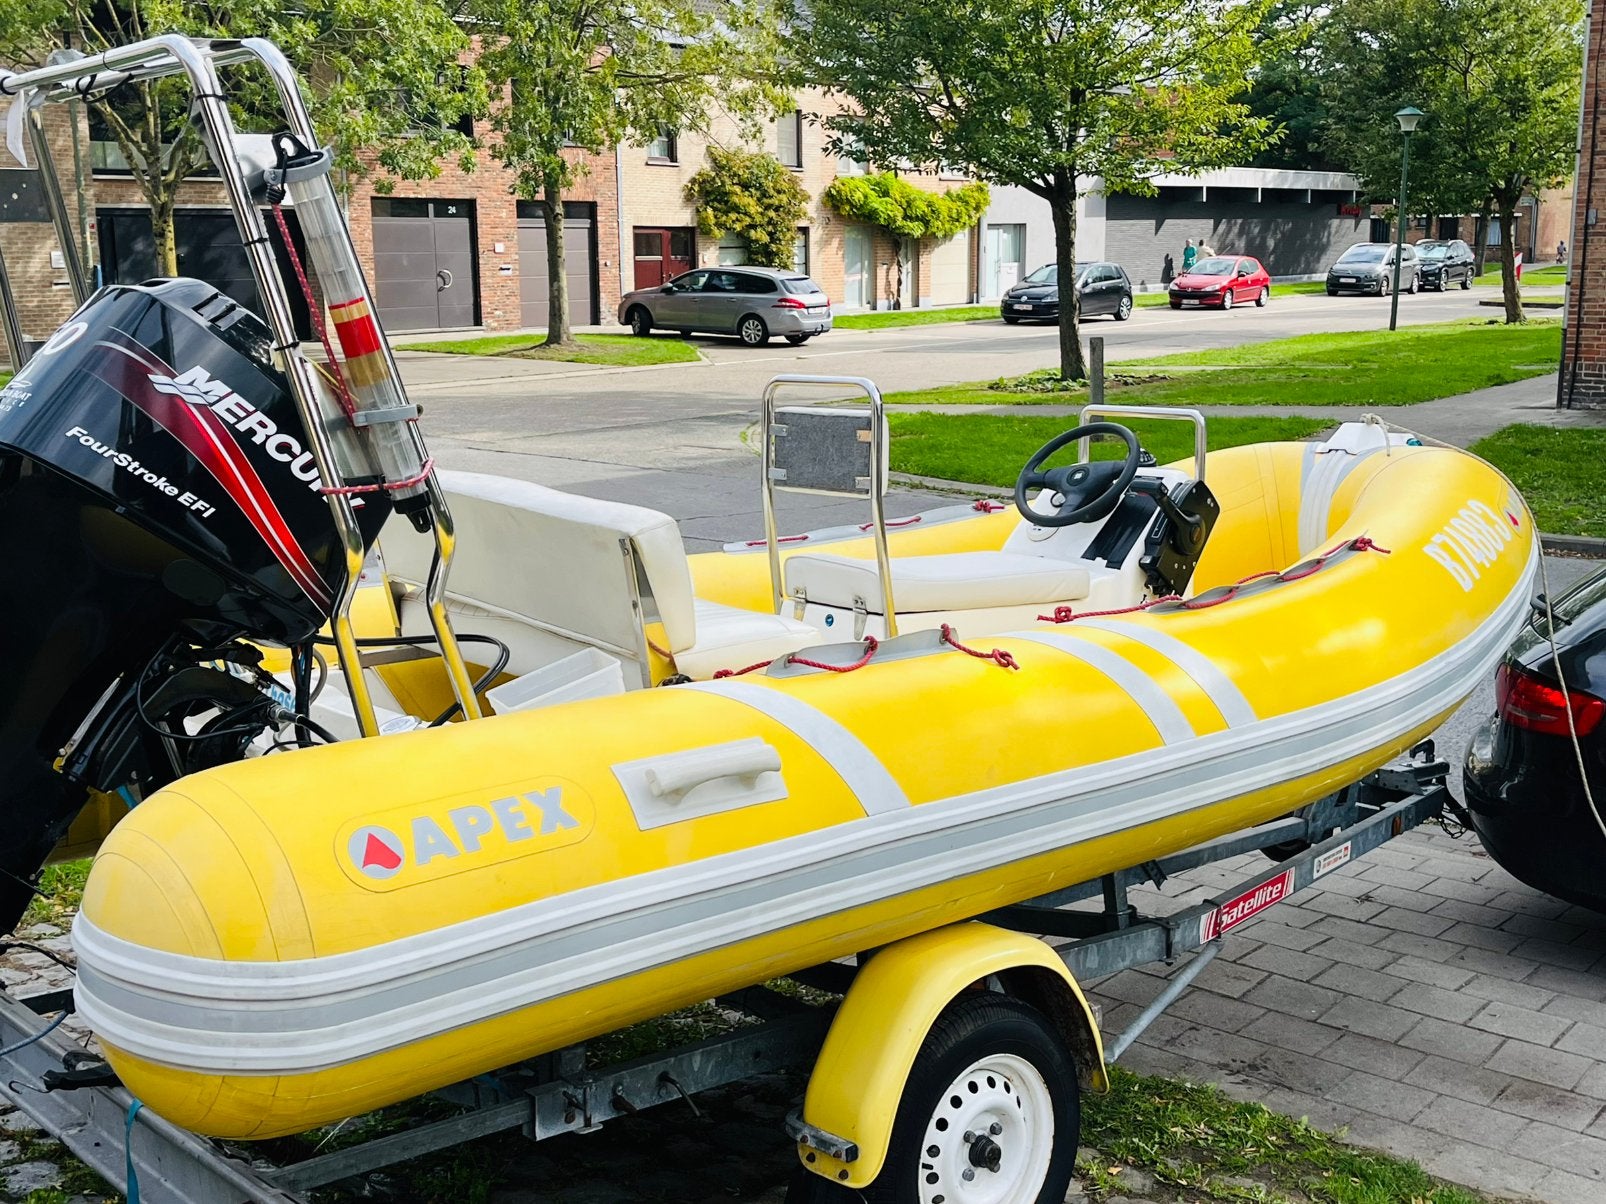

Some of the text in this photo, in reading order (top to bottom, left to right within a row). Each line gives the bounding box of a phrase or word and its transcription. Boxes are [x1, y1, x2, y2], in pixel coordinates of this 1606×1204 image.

[447, 205, 457, 214] 24
[64, 425, 217, 518] FourStroke EFI
[170, 364, 367, 508] MERCU
[410, 785, 581, 866] APEX
[1216, 881, 1283, 932] Satellite
